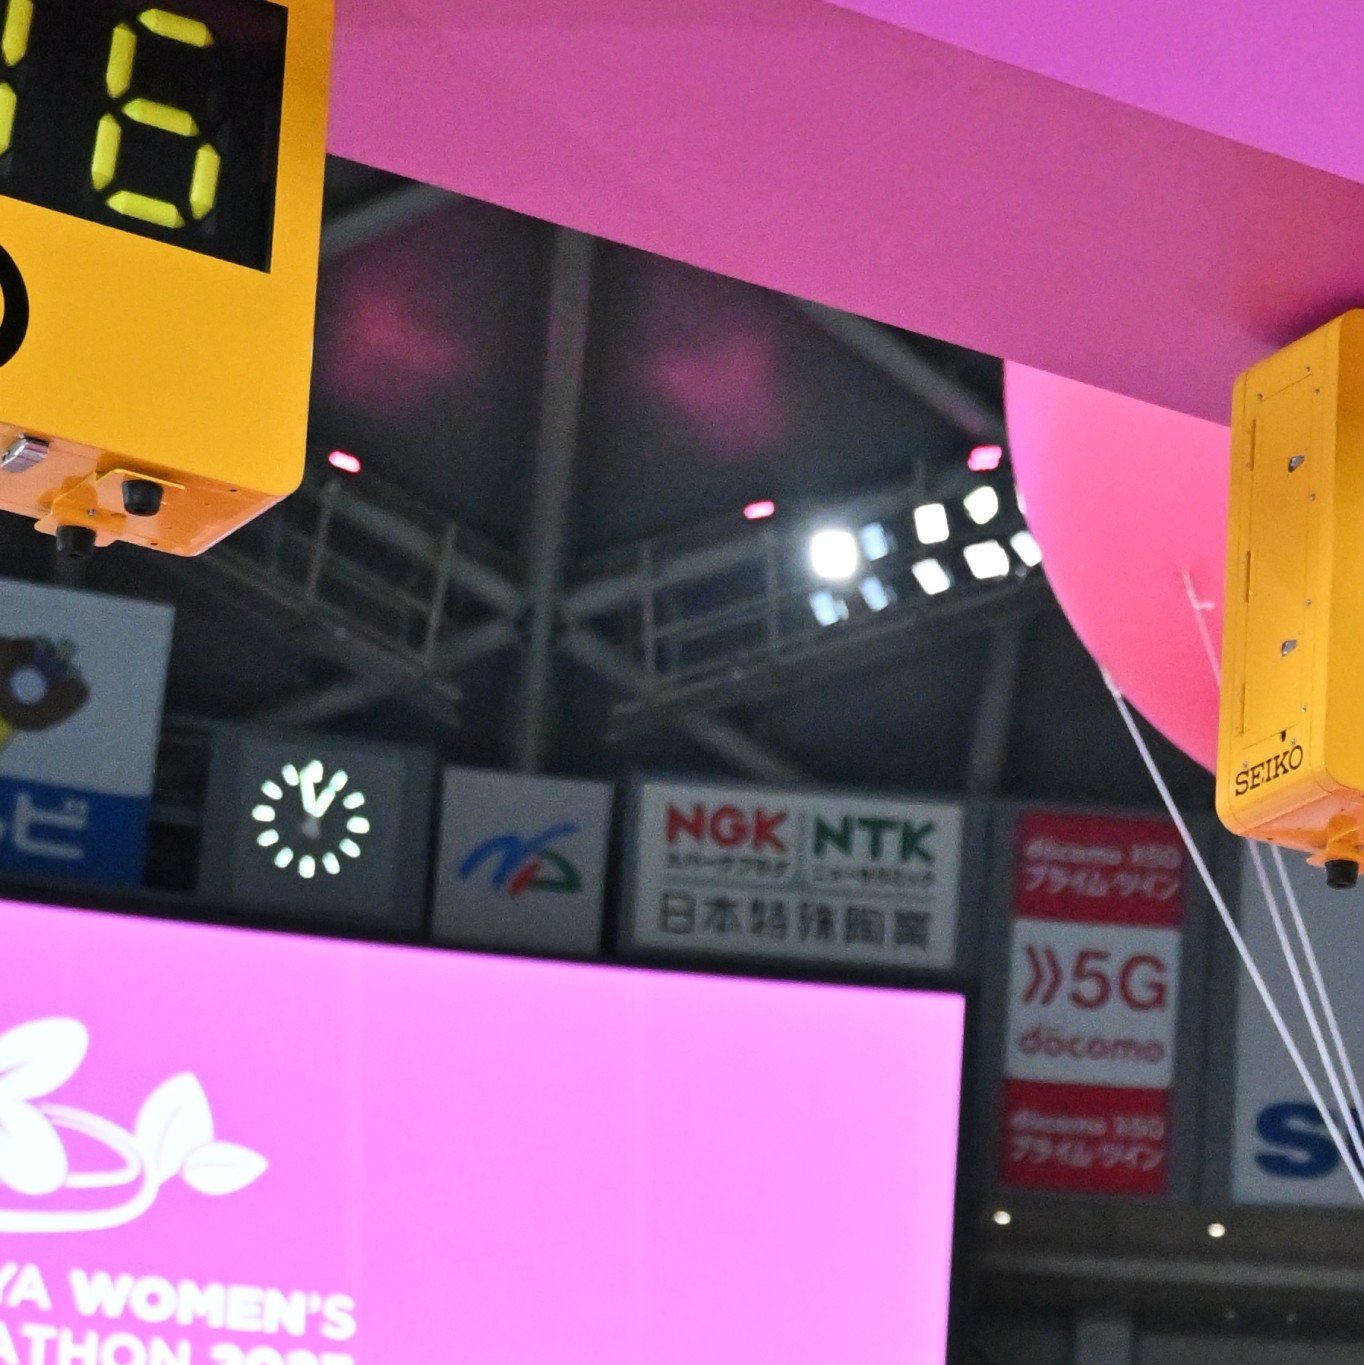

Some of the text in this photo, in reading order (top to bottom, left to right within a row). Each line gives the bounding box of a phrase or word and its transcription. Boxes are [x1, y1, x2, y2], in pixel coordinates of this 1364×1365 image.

[0, 0, 221, 228] 6
[1235, 745, 1303, 796] SEIKO
[666, 801, 936, 862] NGK NTK
[1019, 1026, 1165, 1062] docomo
[69, 1266, 357, 1341] WOMEN'S
